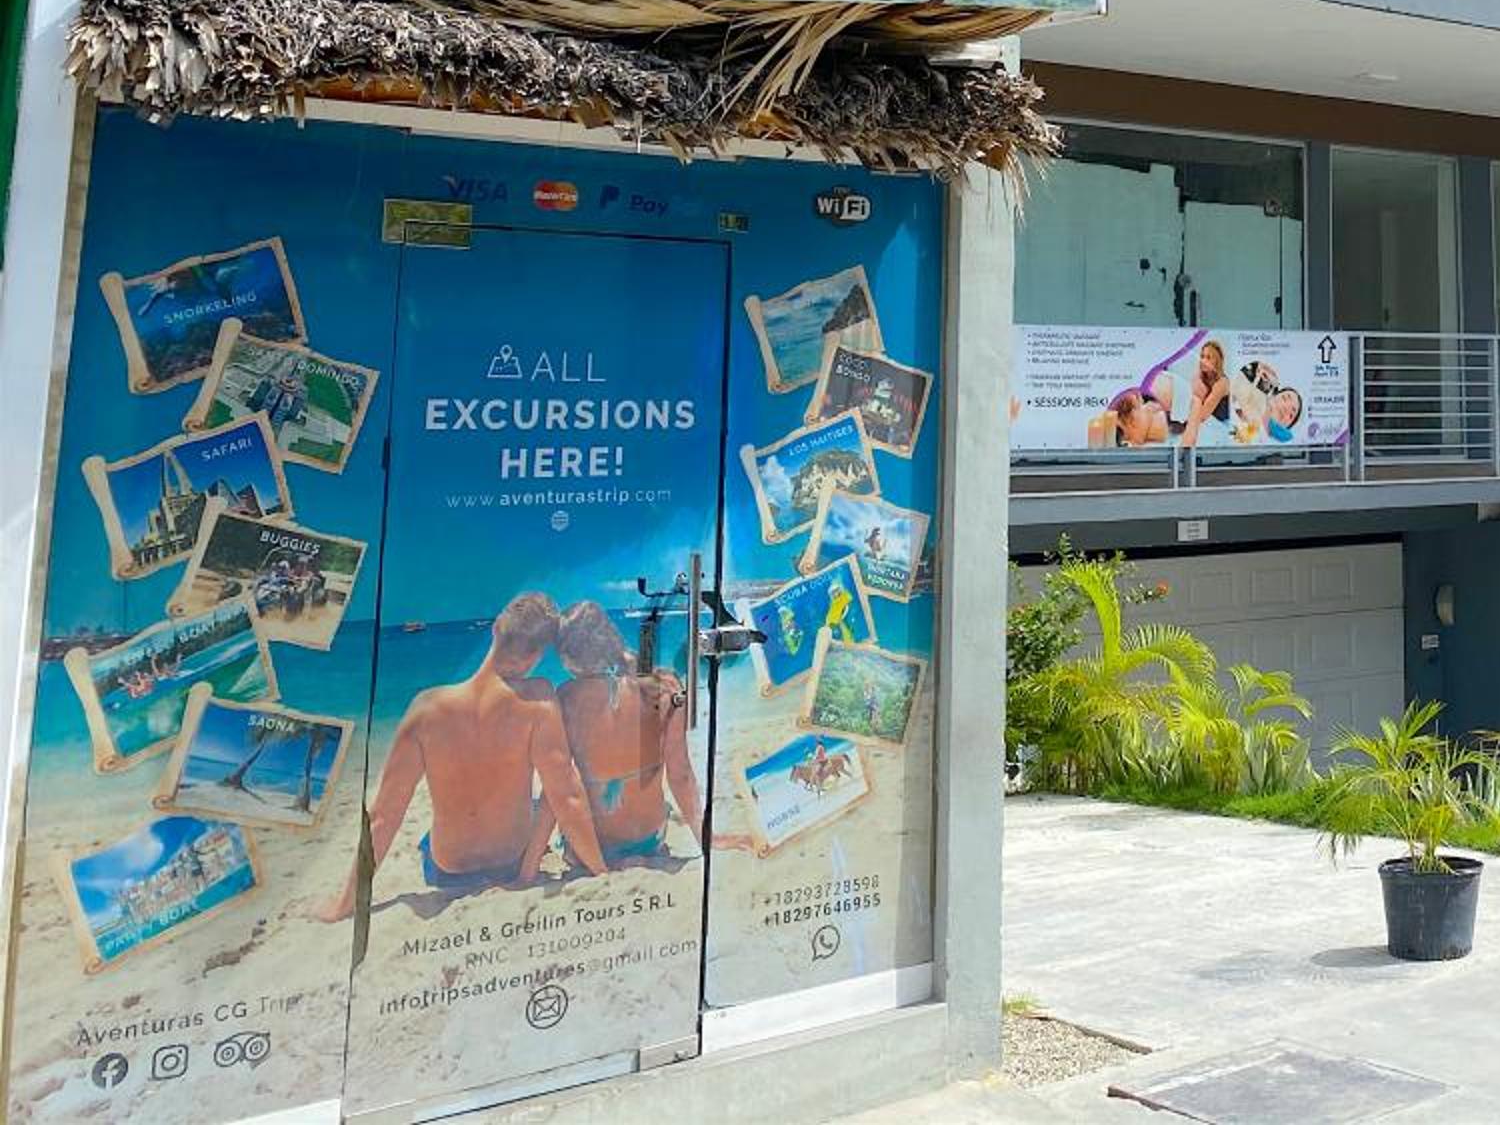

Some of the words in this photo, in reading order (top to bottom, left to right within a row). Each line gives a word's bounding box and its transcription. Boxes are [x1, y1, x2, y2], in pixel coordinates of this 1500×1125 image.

[445, 175, 509, 205] VISA
[163, 291, 257, 324] SNORKELING
[531, 351, 607, 383] ALL
[425, 398, 696, 431] EXCURSIONS
[1034, 396, 1082, 408] SESSIONS
[201, 437, 252, 461] SAFARI
[501, 447, 624, 479] HERE!
[446, 486, 672, 508] www.aventurastrip.com
[260, 530, 321, 555] BUGGIES
[247, 714, 296, 733] SAONA
[764, 875, 880, 907] +18293728598
[764, 892, 882, 926] +18297646955
[402, 930, 471, 957] Mizael
[479, 924, 492, 942] &
[574, 901, 626, 924] Tours
[465, 946, 510, 971] RNC
[76, 1012, 204, 1047] Aventuras
[214, 1001, 248, 1022] CG
